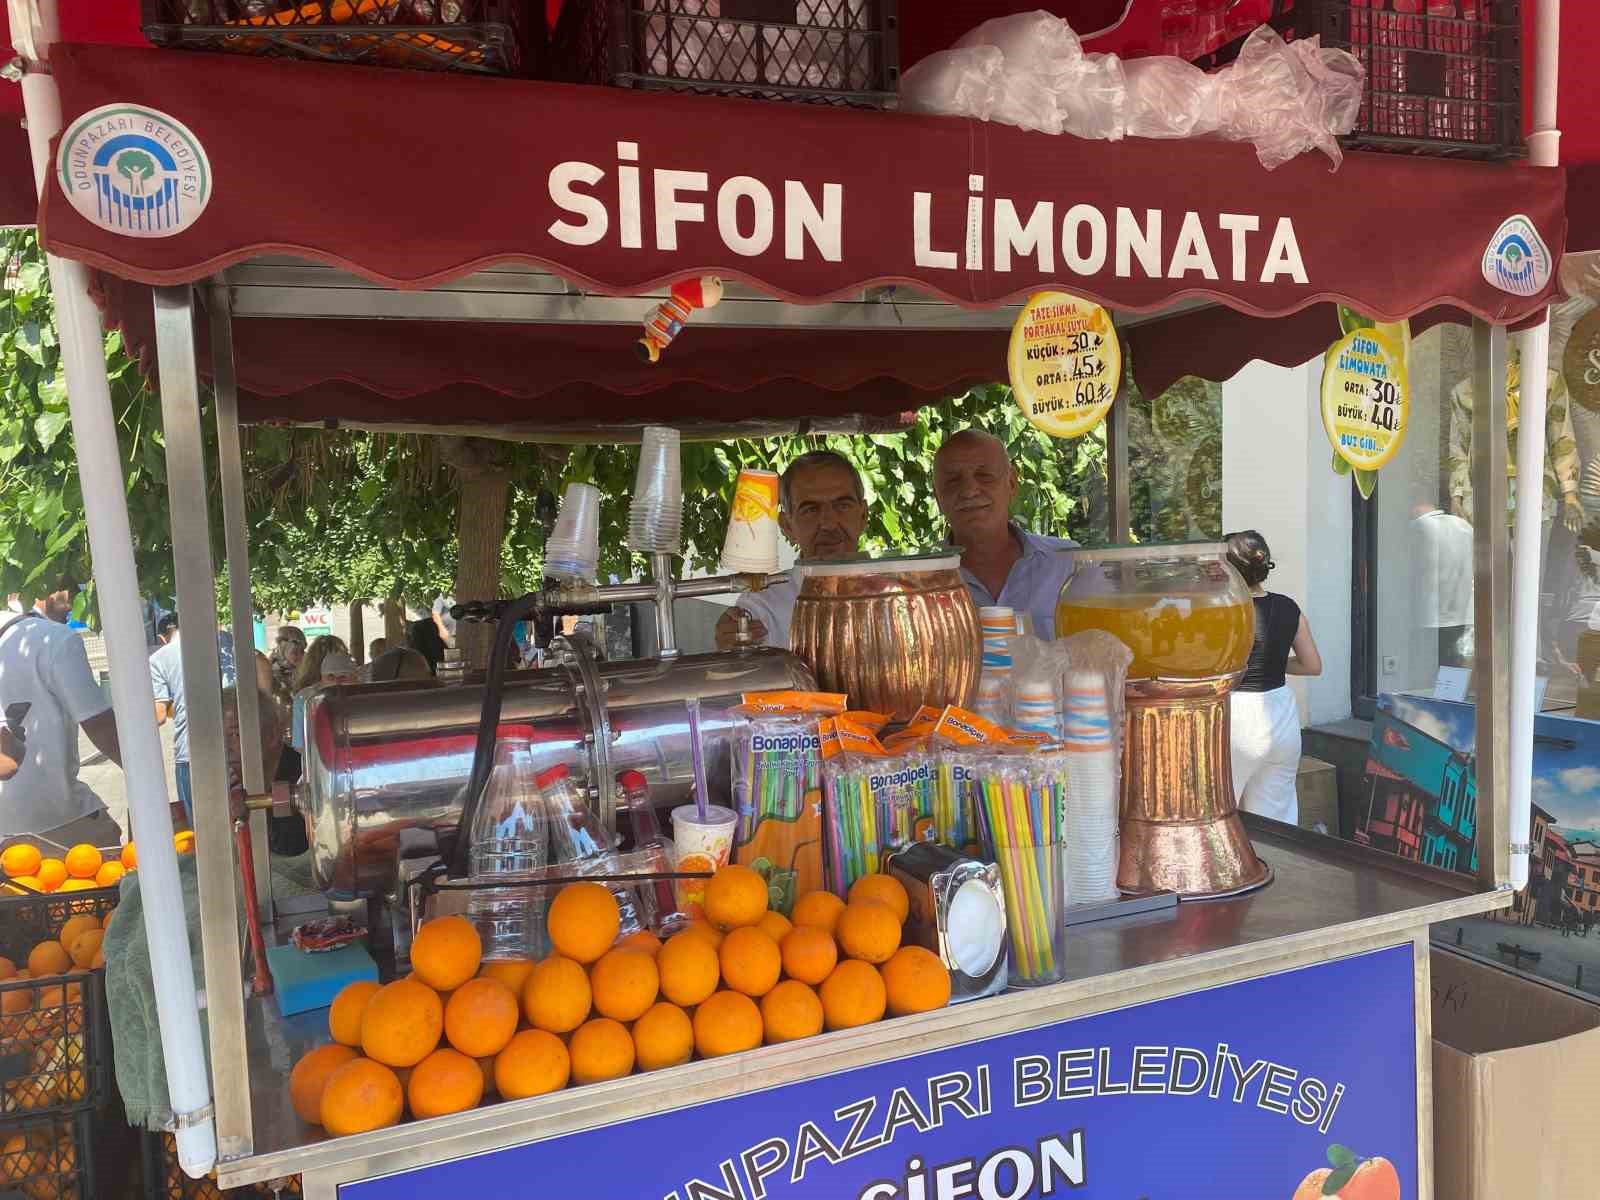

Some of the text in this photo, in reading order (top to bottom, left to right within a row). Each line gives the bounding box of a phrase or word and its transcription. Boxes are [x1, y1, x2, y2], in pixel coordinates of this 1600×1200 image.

[73, 118, 134, 191] ODUNPAZARI
[547, 140, 1310, 285] SİFON LİMONATA
[1023, 323, 1066, 338] PORTAKAL
[1351, 333, 1379, 356] SİFON
[1338, 350, 1388, 379] LİMONATA
[304, 614, 328, 625] WC
[869, 762, 930, 793] Bonapipet
[664, 1043, 1345, 1200] NPAZARI BELEDİYESİ
